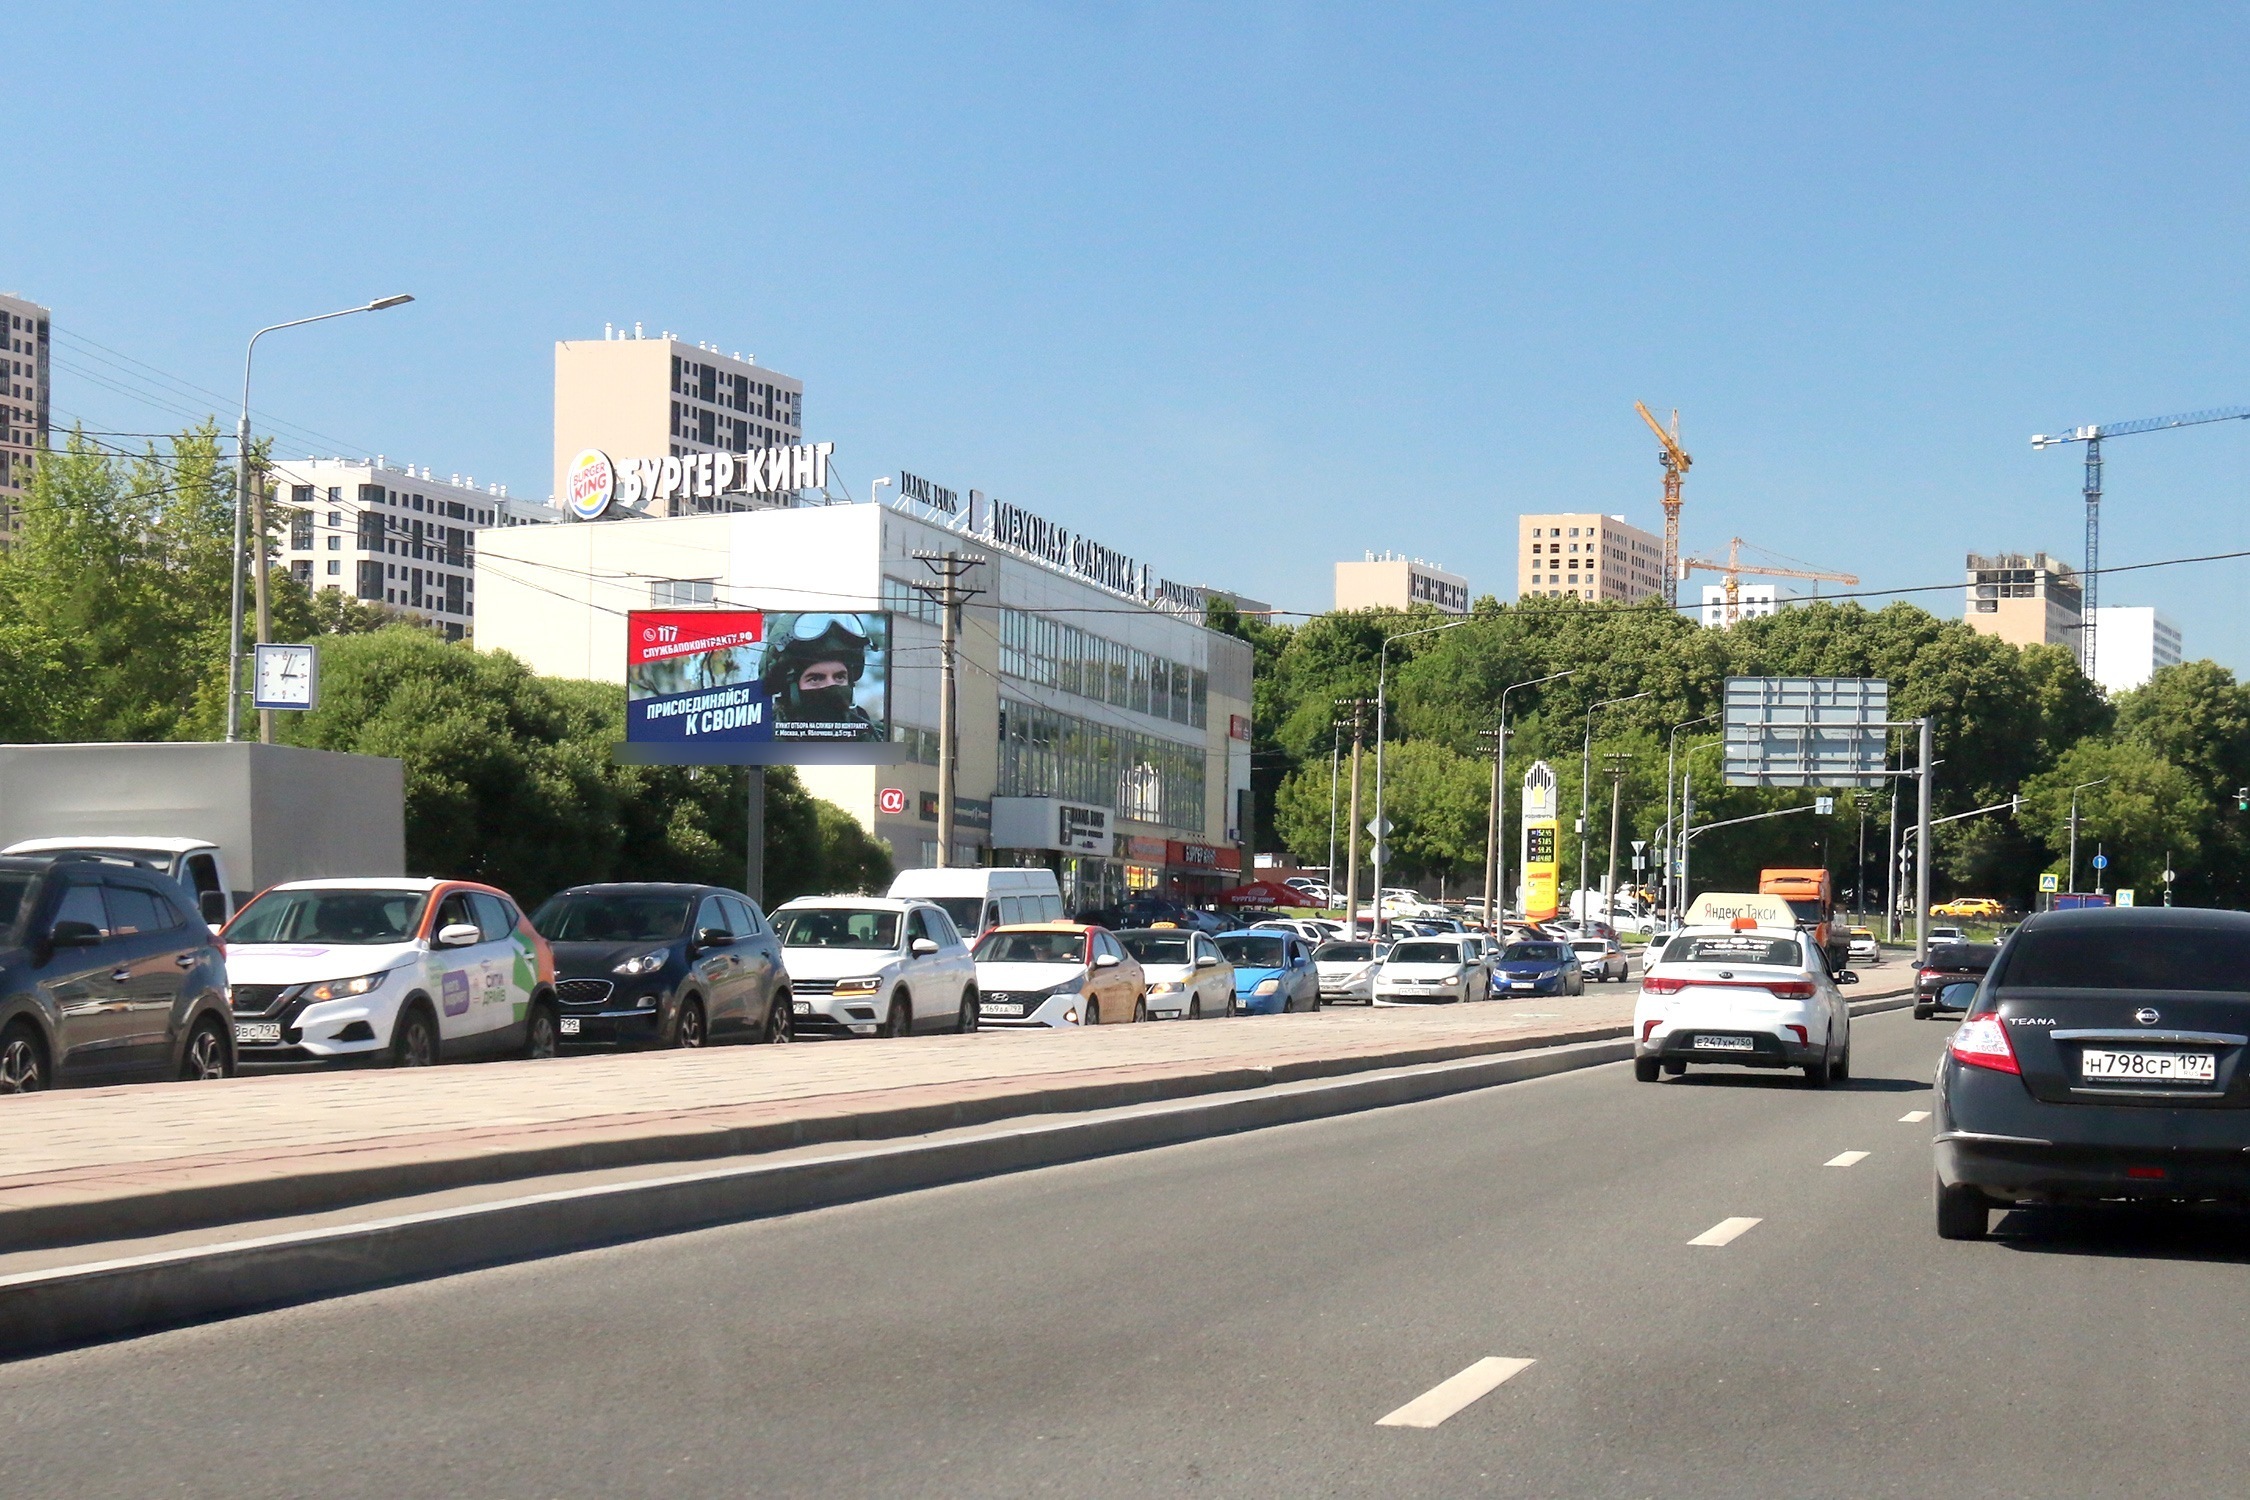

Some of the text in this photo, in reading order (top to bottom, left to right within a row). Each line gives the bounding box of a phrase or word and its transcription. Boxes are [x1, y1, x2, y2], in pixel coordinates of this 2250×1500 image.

[573, 461, 605, 486] BURGER
[622, 442, 834, 504] БУРГЕР КИНГ
[574, 473, 607, 502] KING
[934, 484, 958, 515] FURS
[994, 499, 1134, 595] МЕХОВАЯ ФАБРИКА
[643, 631, 753, 658] СЛУЖБАПОКОНТРАКТУ.РФ
[658, 626, 678, 642] 117
[647, 687, 750, 719] ПРИСОЕДИНЯЙСЯ
[686, 703, 762, 735] К СВОИМ
[1705, 903, 1776, 920] Яндекс Такси
[258, 1024, 276, 1034] 797
[2009, 1018, 2056, 1026] TEANA
[2178, 1055, 2208, 1070] 197
